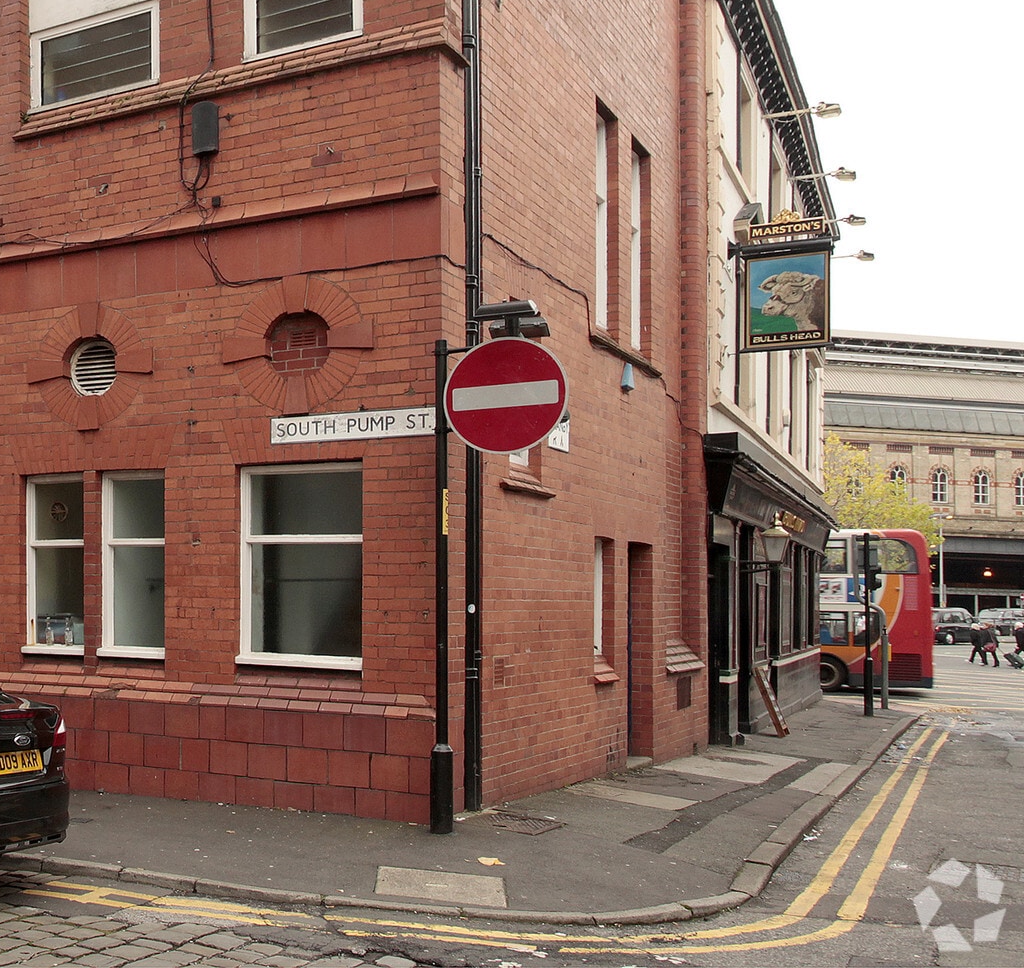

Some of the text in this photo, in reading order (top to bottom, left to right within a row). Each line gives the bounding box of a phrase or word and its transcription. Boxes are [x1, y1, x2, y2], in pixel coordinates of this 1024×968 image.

[751, 221, 821, 237] MARSTON'S
[752, 331, 821, 344] BULLS HEAD
[276, 413, 432, 438] SOUTH PUMP ST.
[20, 751, 39, 769] AXR
